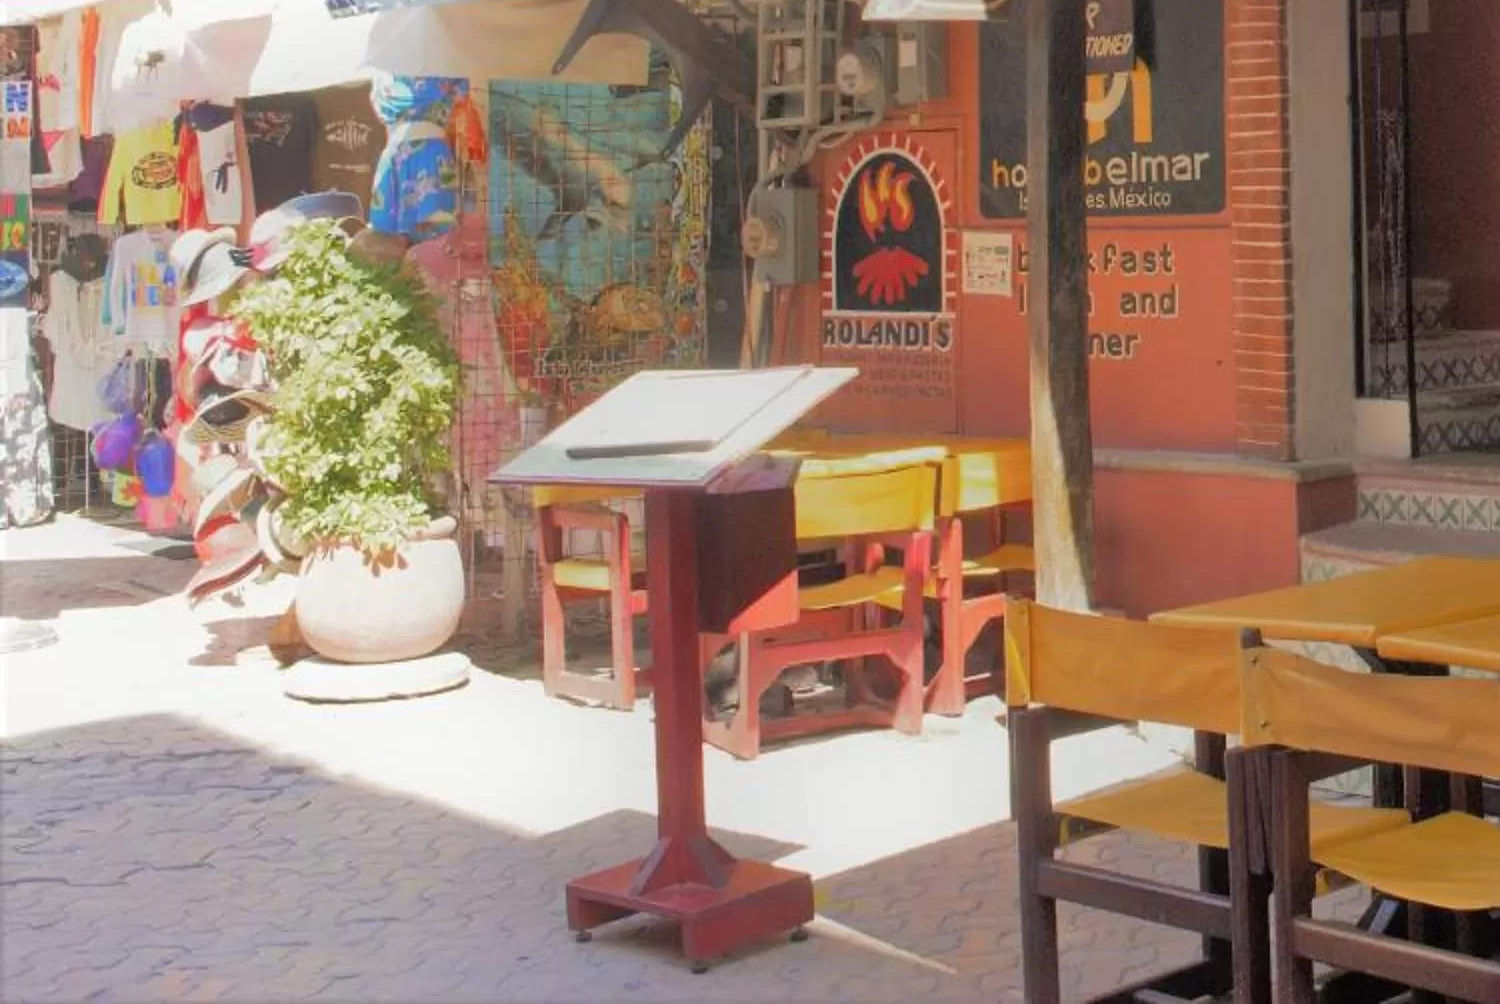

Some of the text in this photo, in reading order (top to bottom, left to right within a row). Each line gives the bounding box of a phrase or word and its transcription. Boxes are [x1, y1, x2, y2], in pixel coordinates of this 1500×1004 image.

[1084, 151, 1210, 186] belmar
[1119, 284, 1180, 319] and
[822, 314, 953, 353] ROLANDI'S
[1089, 332, 1141, 360] ner
